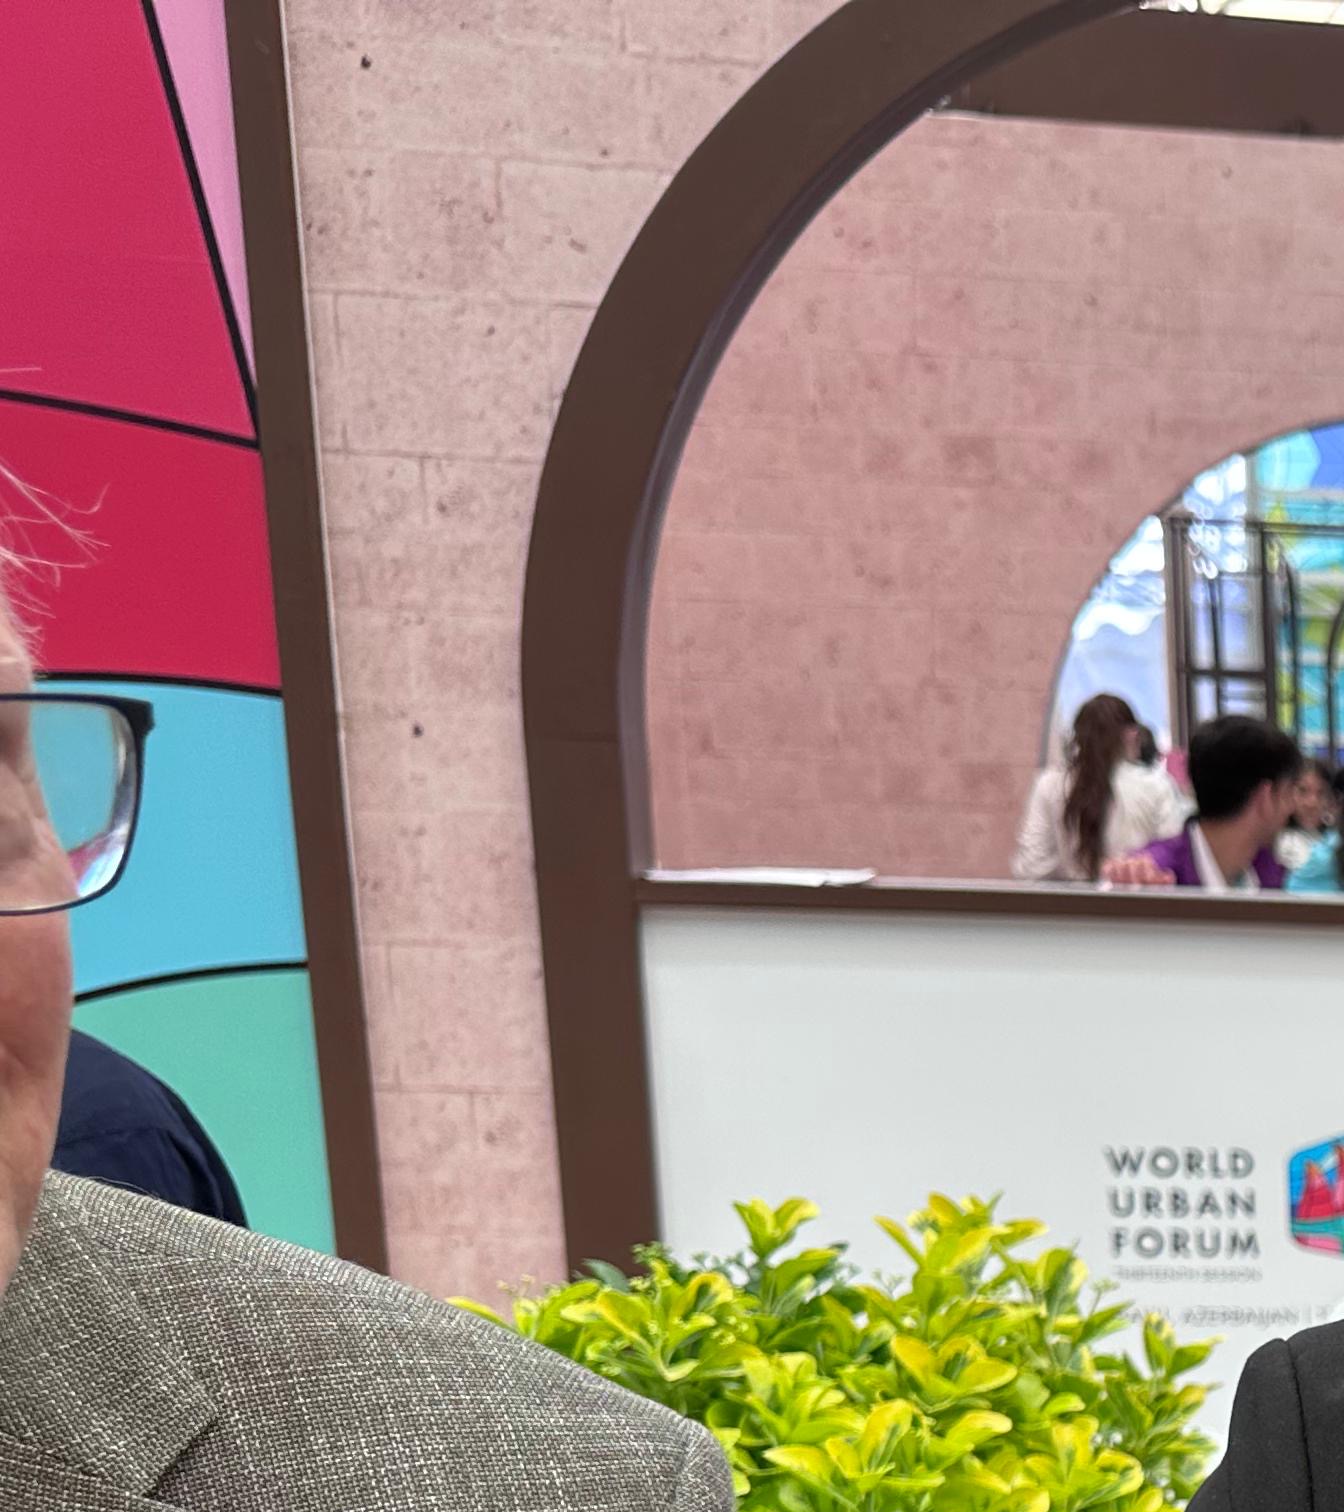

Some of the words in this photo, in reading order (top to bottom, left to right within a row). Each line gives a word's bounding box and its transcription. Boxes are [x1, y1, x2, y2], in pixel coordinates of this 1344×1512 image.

[1104, 1147, 1256, 1179] WORLD
[1107, 1187, 1257, 1219] URBAN
[1110, 1227, 1261, 1259] FORUM
